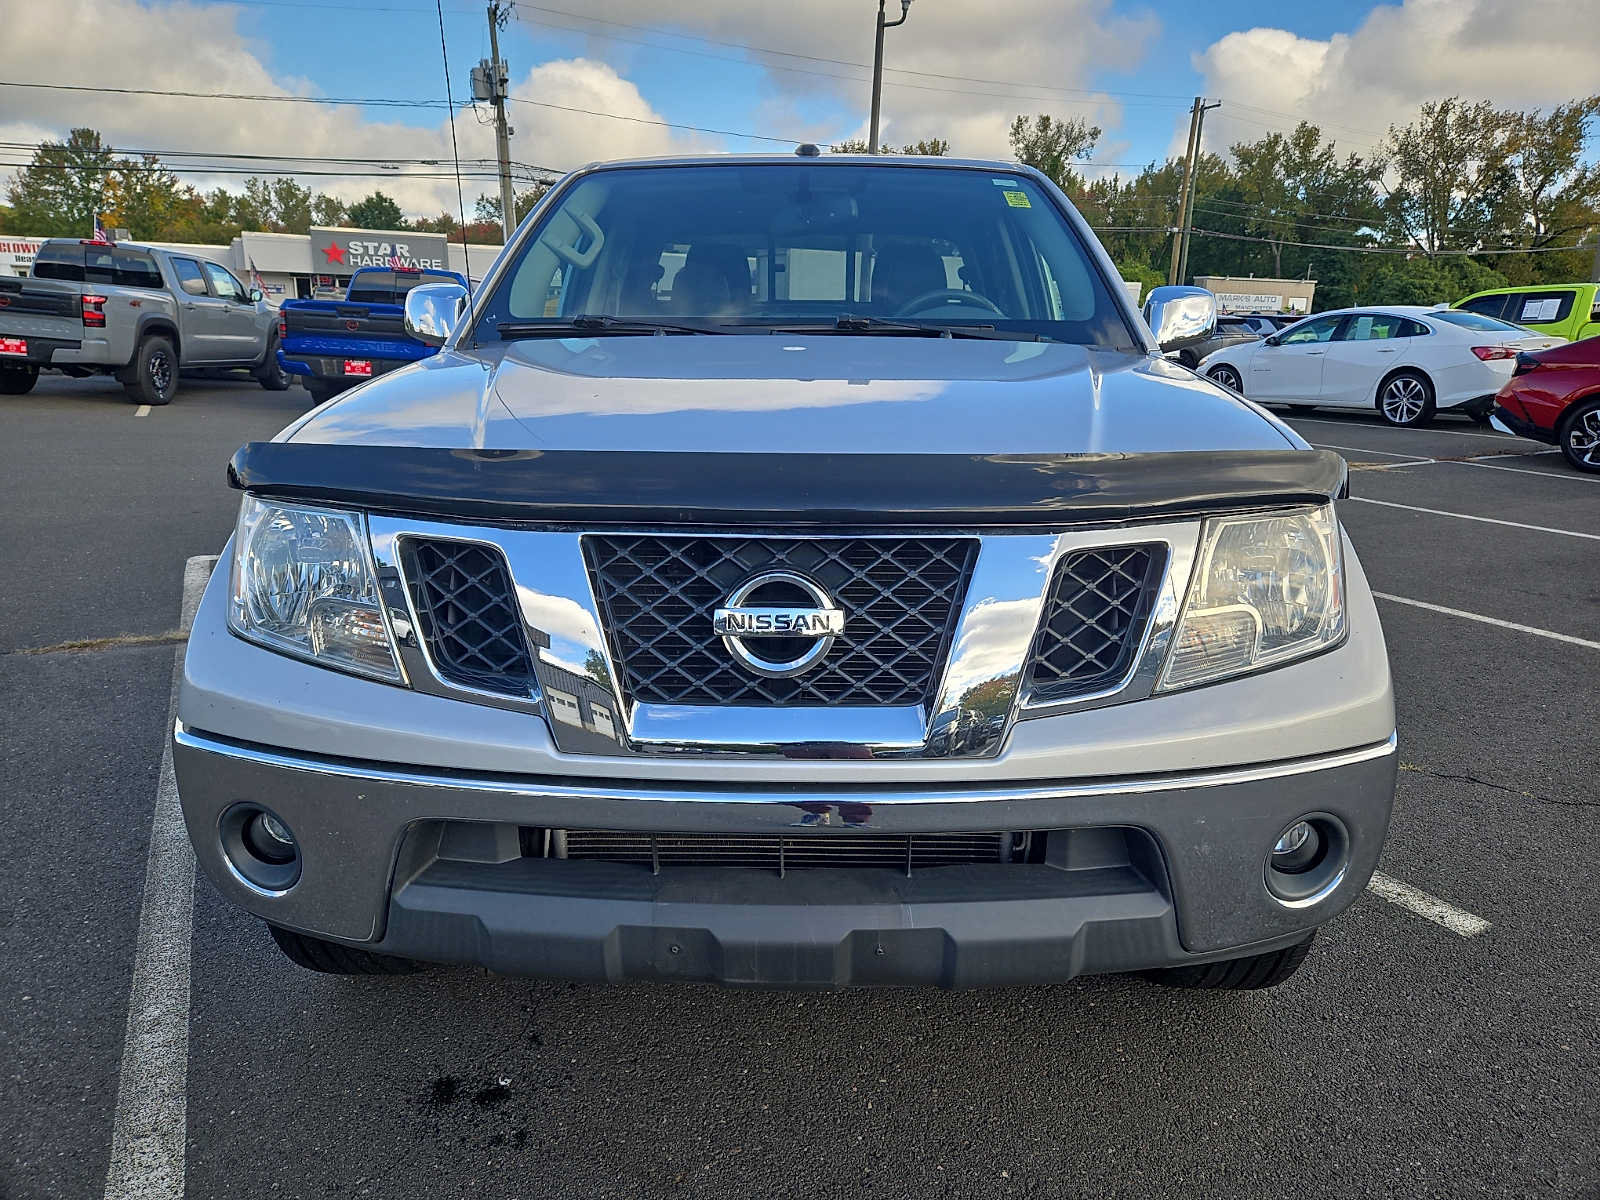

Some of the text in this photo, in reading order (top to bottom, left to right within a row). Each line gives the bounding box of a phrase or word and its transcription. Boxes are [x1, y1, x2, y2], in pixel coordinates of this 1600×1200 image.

[349, 241, 410, 257] STAR
[349, 255, 442, 270] HARDWARE
[726, 613, 830, 631] NISSAN
